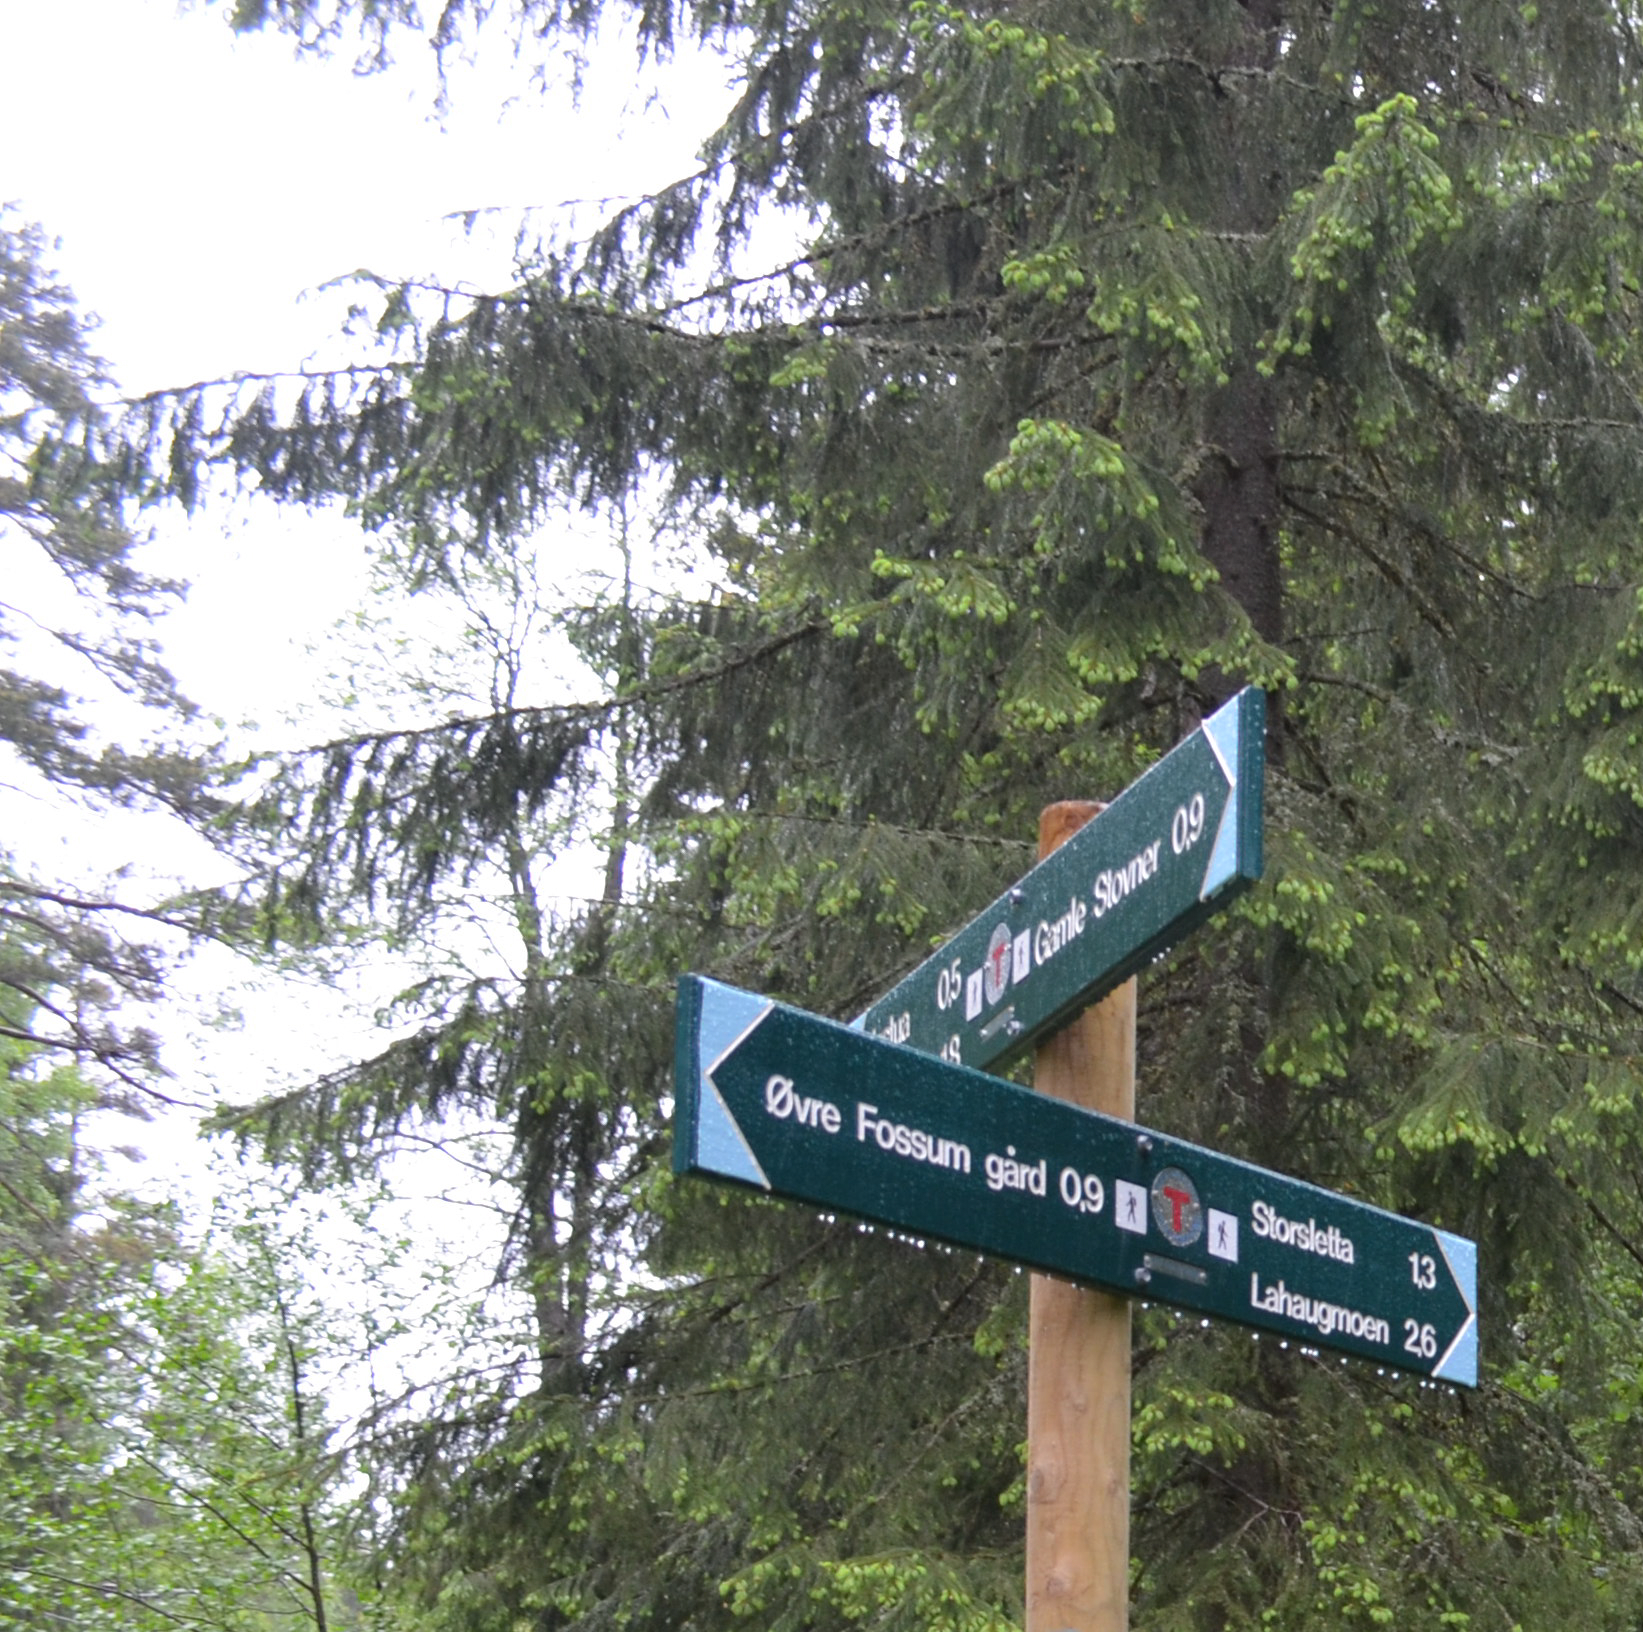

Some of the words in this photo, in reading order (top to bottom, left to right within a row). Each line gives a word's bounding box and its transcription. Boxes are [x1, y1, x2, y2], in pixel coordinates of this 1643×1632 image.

[1034, 897, 1087, 966] Gamle
[1093, 840, 1161, 918] Stovner
[1171, 792, 1204, 855] 0,9
[937, 957, 962, 1011] 0,5
[765, 1074, 842, 1134] Øvre
[857, 1102, 971, 1173] Fossum
[985, 1145, 1047, 1196] gård
[1059, 1167, 1104, 1213] 0,9
[1251, 1200, 1354, 1265] Storsletta
[1251, 1272, 1389, 1345] Lahaugmoen
[1404, 1318, 1437, 1358] 2,6
